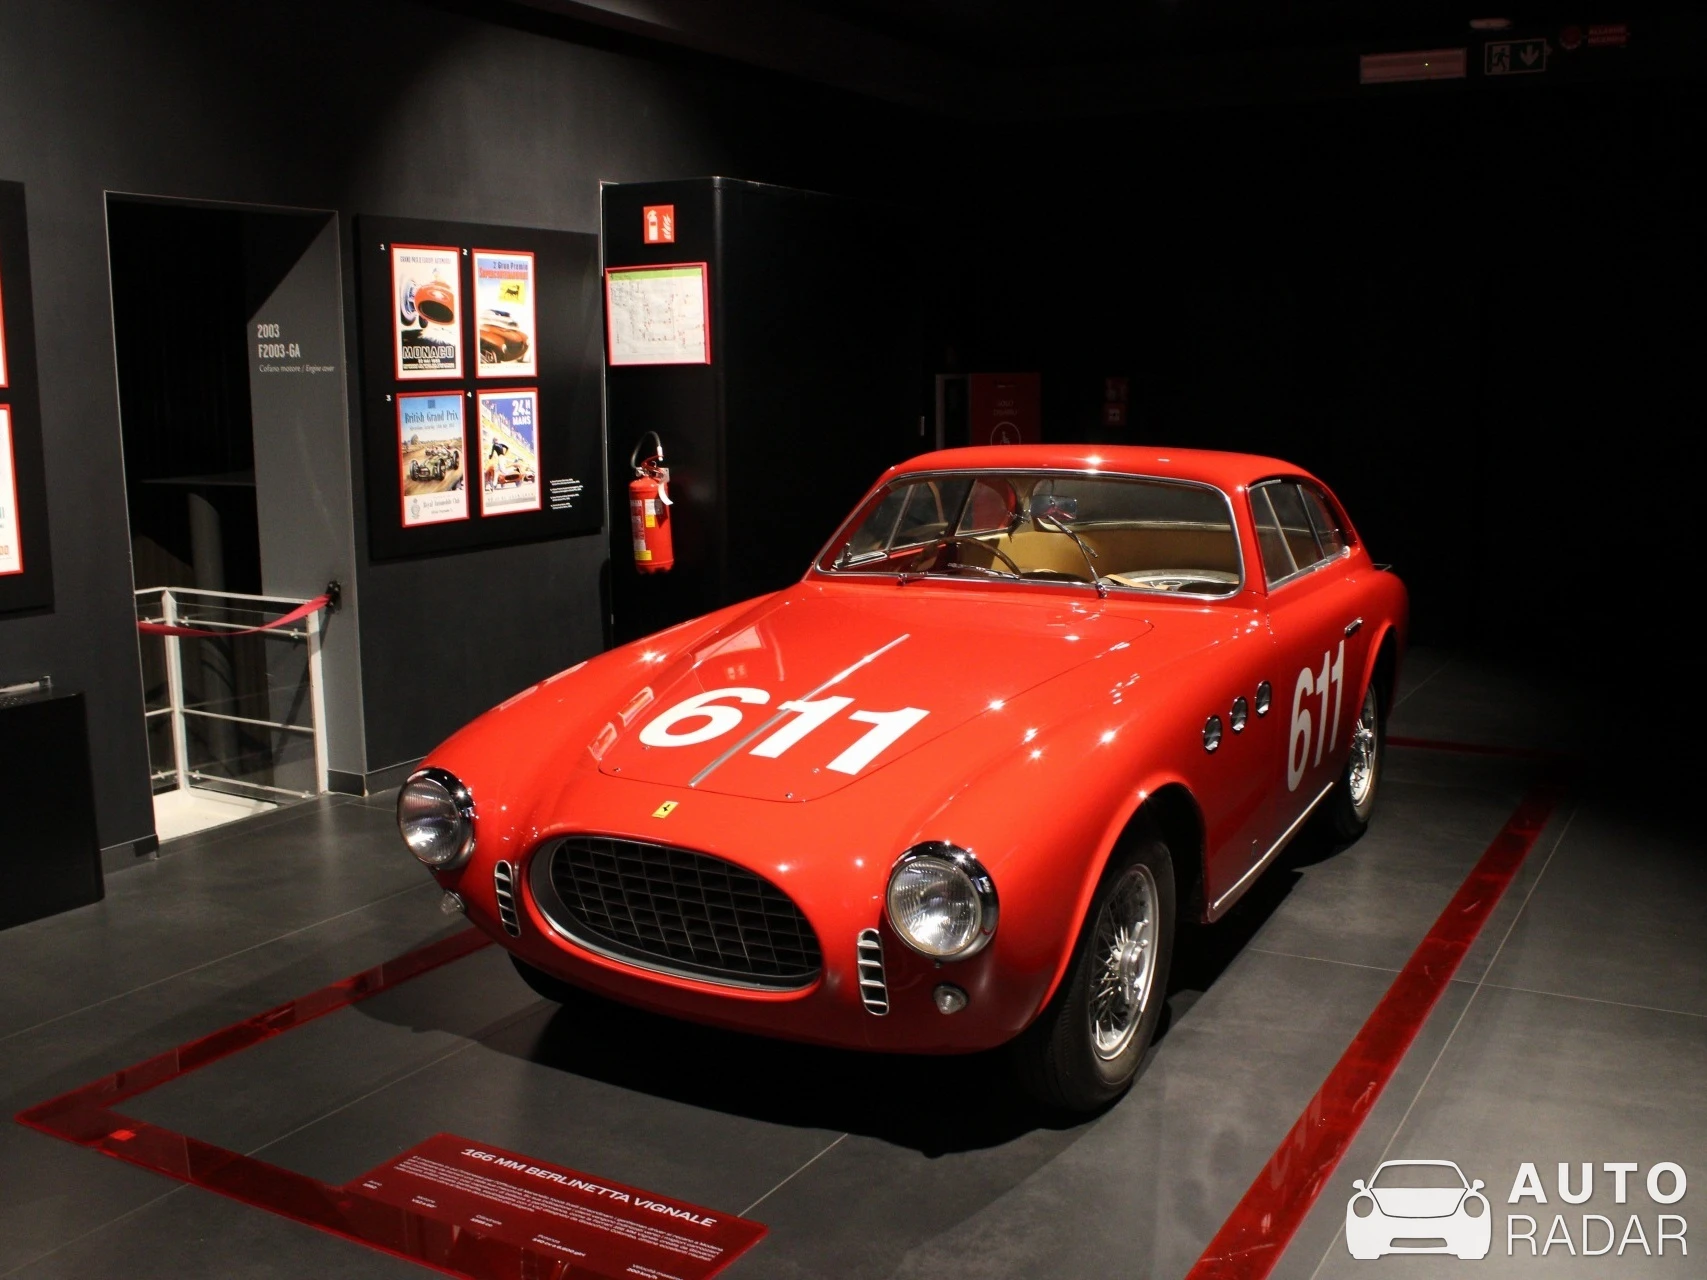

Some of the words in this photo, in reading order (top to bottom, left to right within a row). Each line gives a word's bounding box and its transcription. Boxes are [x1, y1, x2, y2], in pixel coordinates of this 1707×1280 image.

[257, 323, 280, 338] 2003
[258, 343, 301, 358] F2003-GA
[403, 346, 455, 359] MONACO
[405, 412, 424, 423] British
[427, 411, 444, 422] Grand
[446, 410, 459, 421] Prix
[1287, 640, 1345, 792] 611
[639, 687, 931, 776] 611
[461, 1149, 496, 1162] 166
[494, 1158, 527, 1171] MM
[525, 1166, 630, 1203] BERLINETTA
[634, 1197, 717, 1227] VIGNALE
